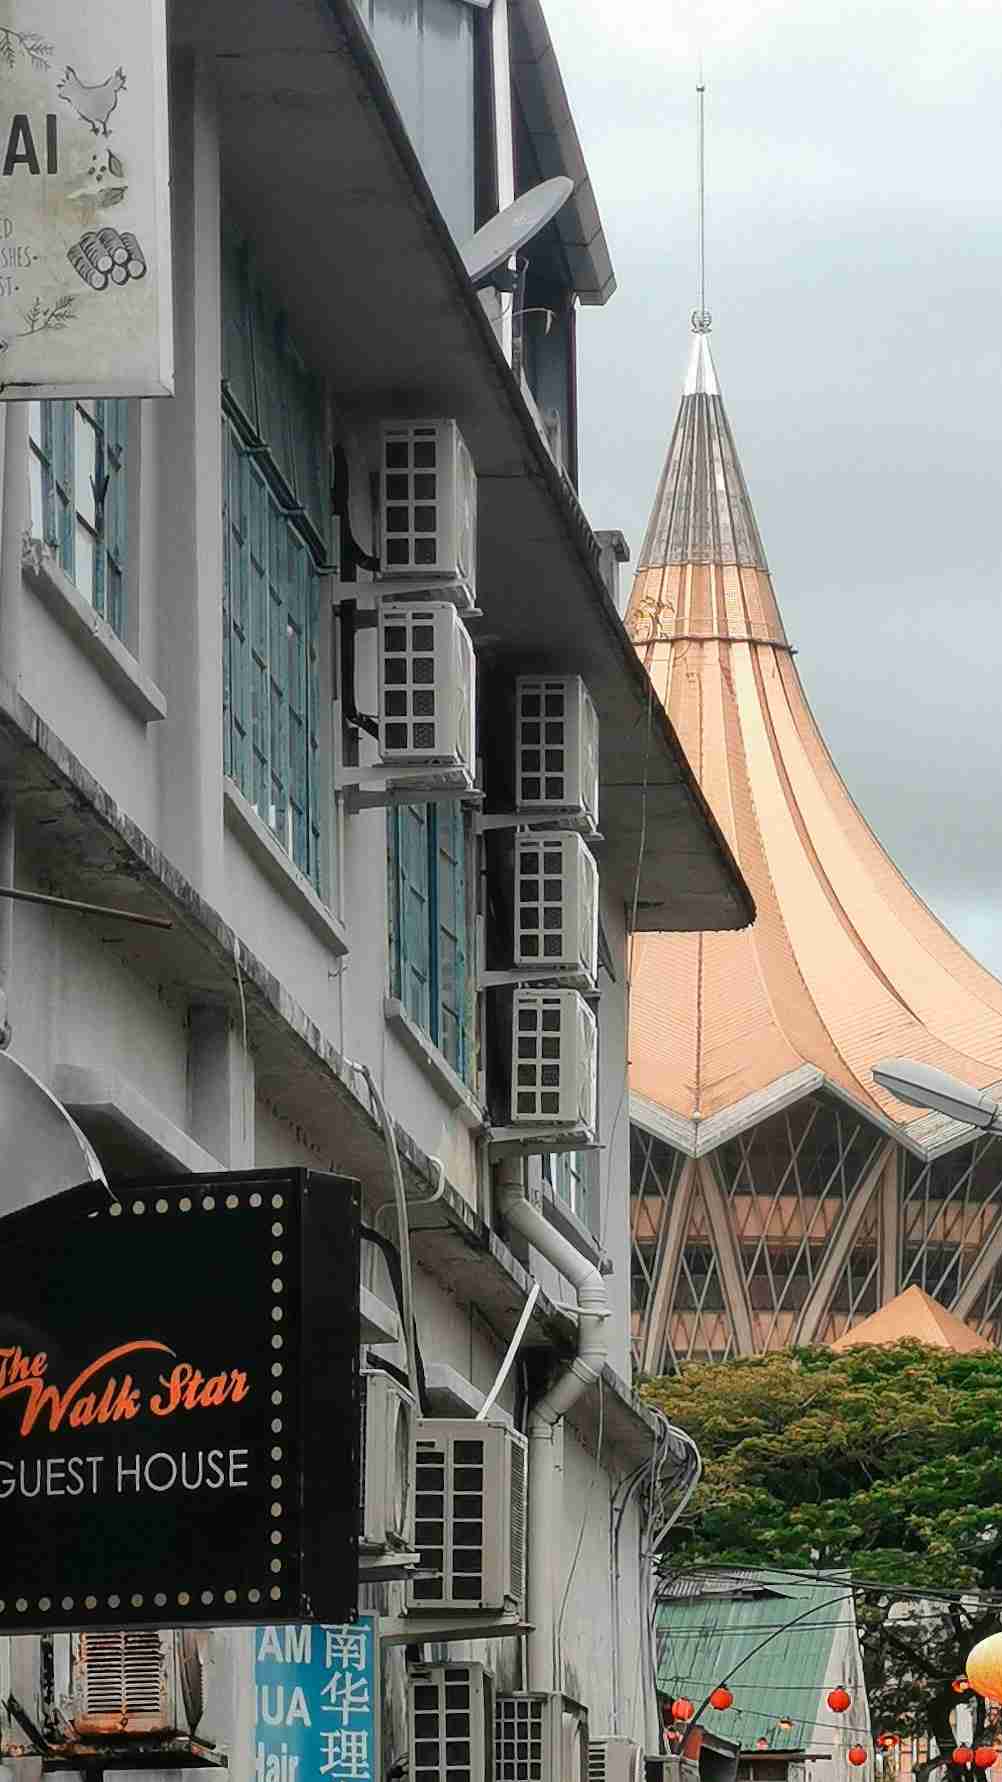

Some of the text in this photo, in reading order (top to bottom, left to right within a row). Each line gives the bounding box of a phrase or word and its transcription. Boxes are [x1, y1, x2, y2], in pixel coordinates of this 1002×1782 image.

[0, 1345, 48, 1384] The
[0, 1340, 250, 1437] Walk Star
[0, 1449, 249, 1498] GUEST HOUSE
